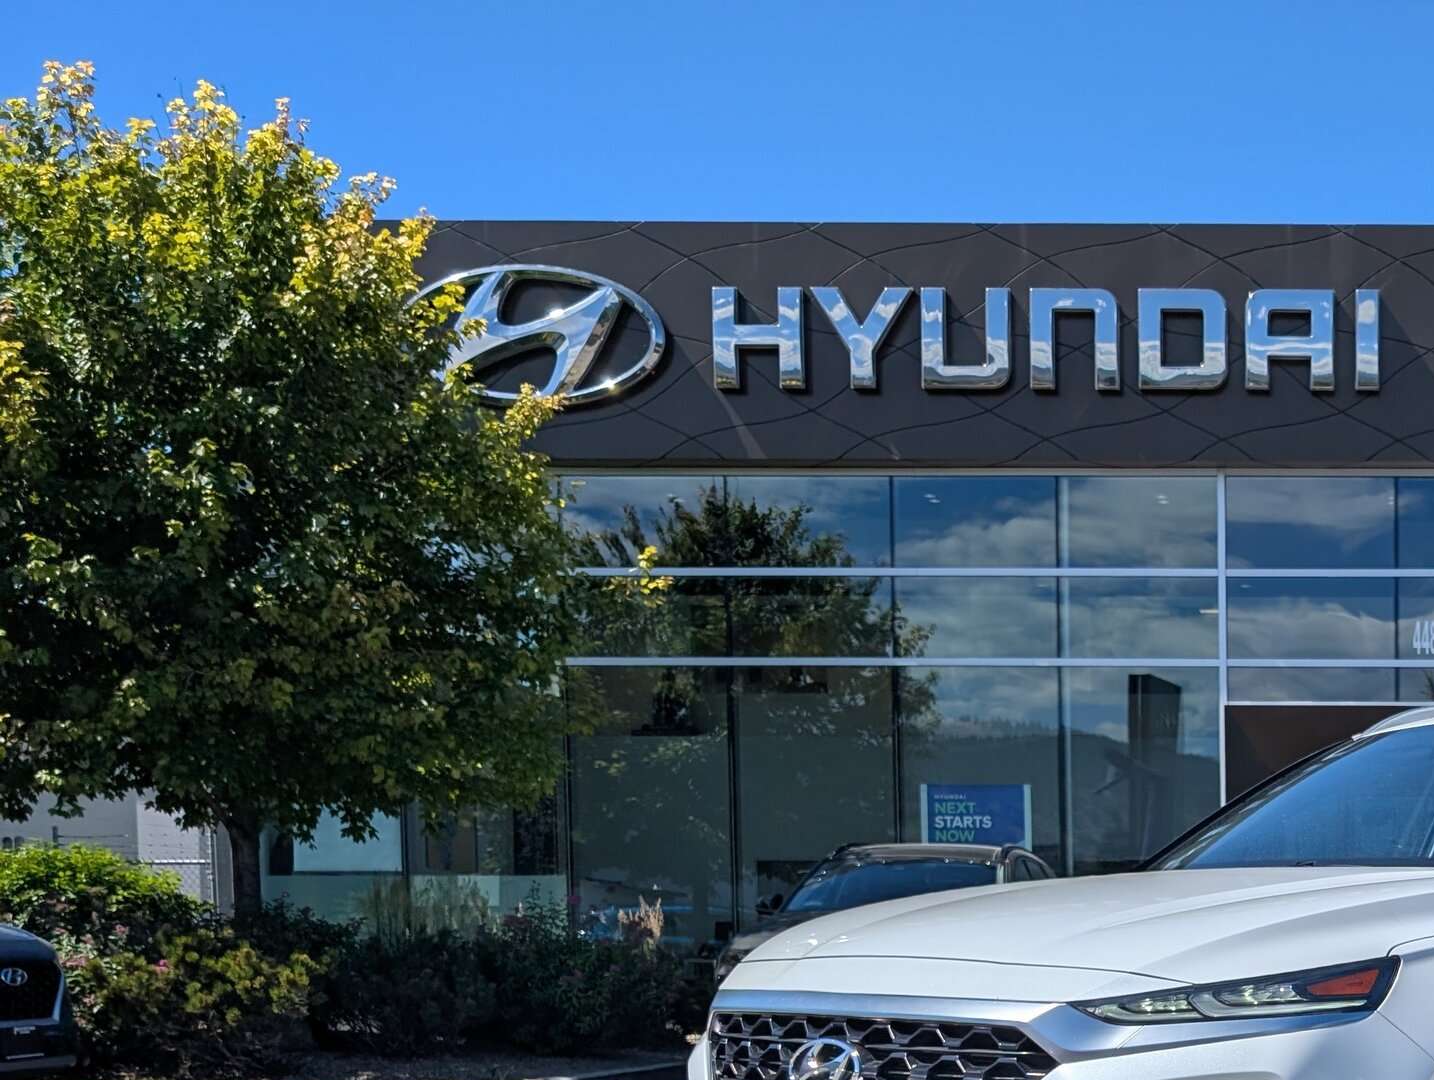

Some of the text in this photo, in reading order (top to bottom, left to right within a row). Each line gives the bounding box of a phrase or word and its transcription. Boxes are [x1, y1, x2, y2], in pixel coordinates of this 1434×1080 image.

[711, 286, 1381, 391] HYUNDAI
[935, 802, 976, 814] NEXT
[934, 815, 993, 829] STARTS
[935, 830, 976, 842] NOW
